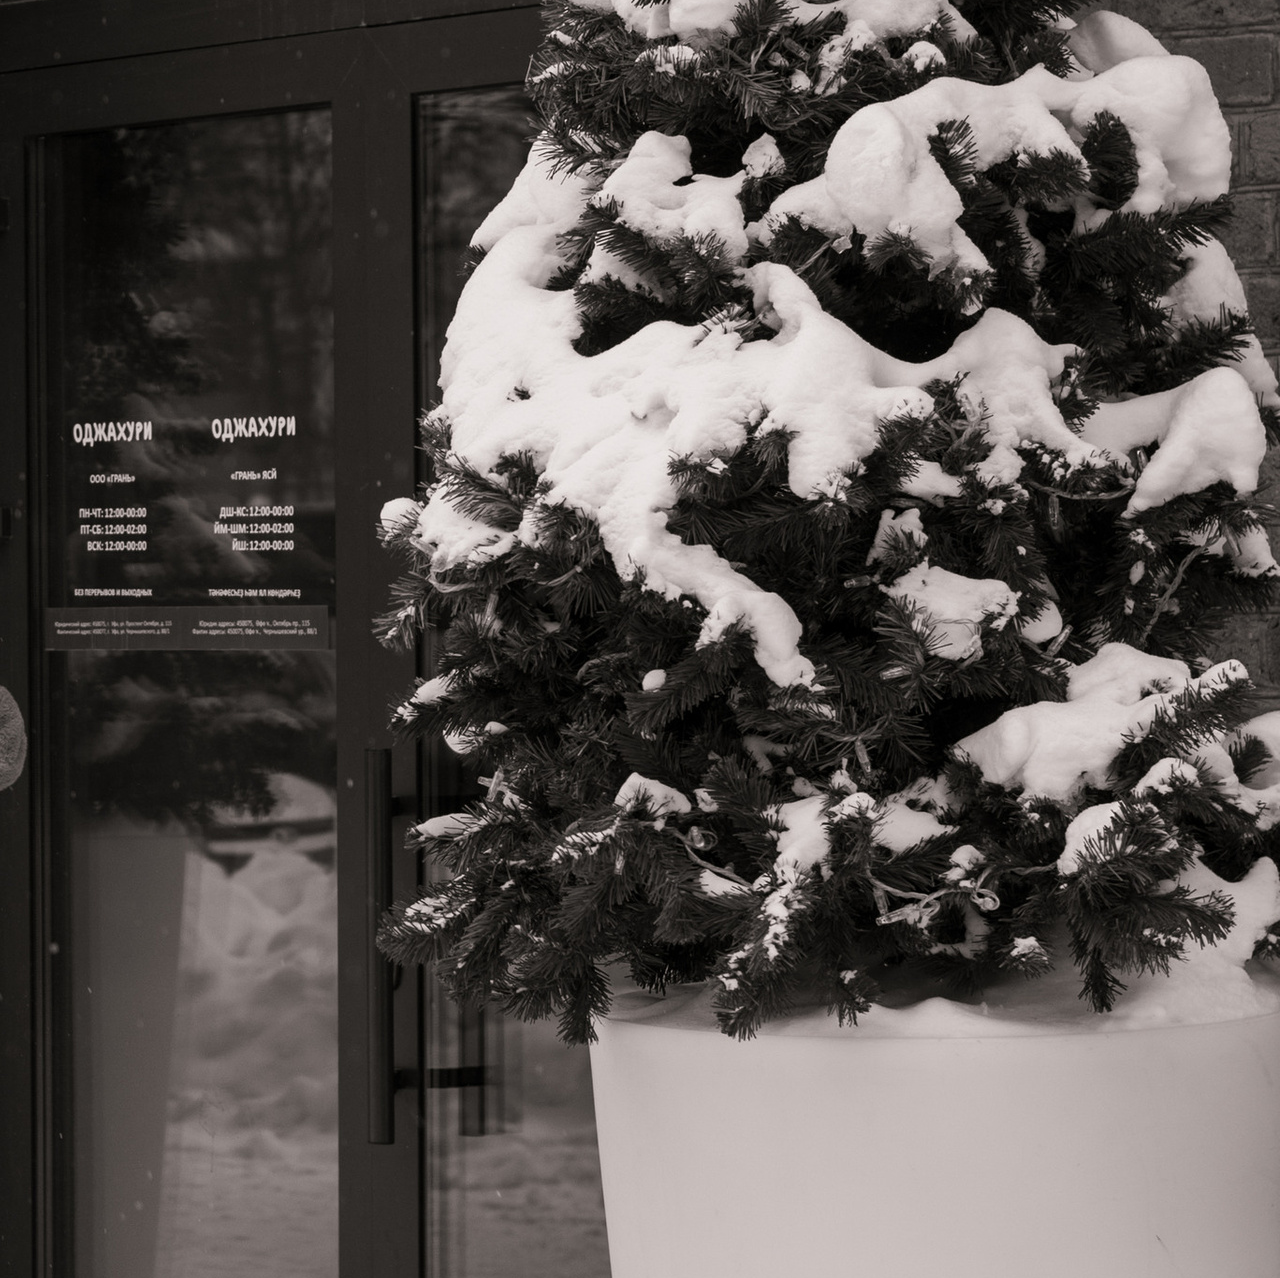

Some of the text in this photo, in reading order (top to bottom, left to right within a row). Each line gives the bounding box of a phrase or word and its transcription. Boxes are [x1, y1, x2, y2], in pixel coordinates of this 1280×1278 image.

[73, 421, 153, 447] ОДЖАХУРИ
[211, 416, 296, 443] ОДЖАХУРИ
[90, 473, 136, 484] ООО «ГРАНЬ»
[231, 470, 261, 481] «ГРАНЬ»
[79, 507, 147, 519] ПН-ЧТ: 12:00-00:00
[219, 505, 294, 519] ДШ-КС: 12:00-00:00
[80, 524, 147, 535] ПТ-СБ: 12:00-02:00
[214, 522, 294, 534] ЙМ-ШМ: 12:00-02:00
[87, 540, 147, 552] ВСК: 12:00-00:00
[232, 538, 294, 551] ЙШ: 12:00-00:00
[74, 588, 84, 597] БЕЗ
[85, 588, 115, 597] ПЕРЕРЫВОВ
[121, 588, 152, 598] ВЫХОДНЫХ
